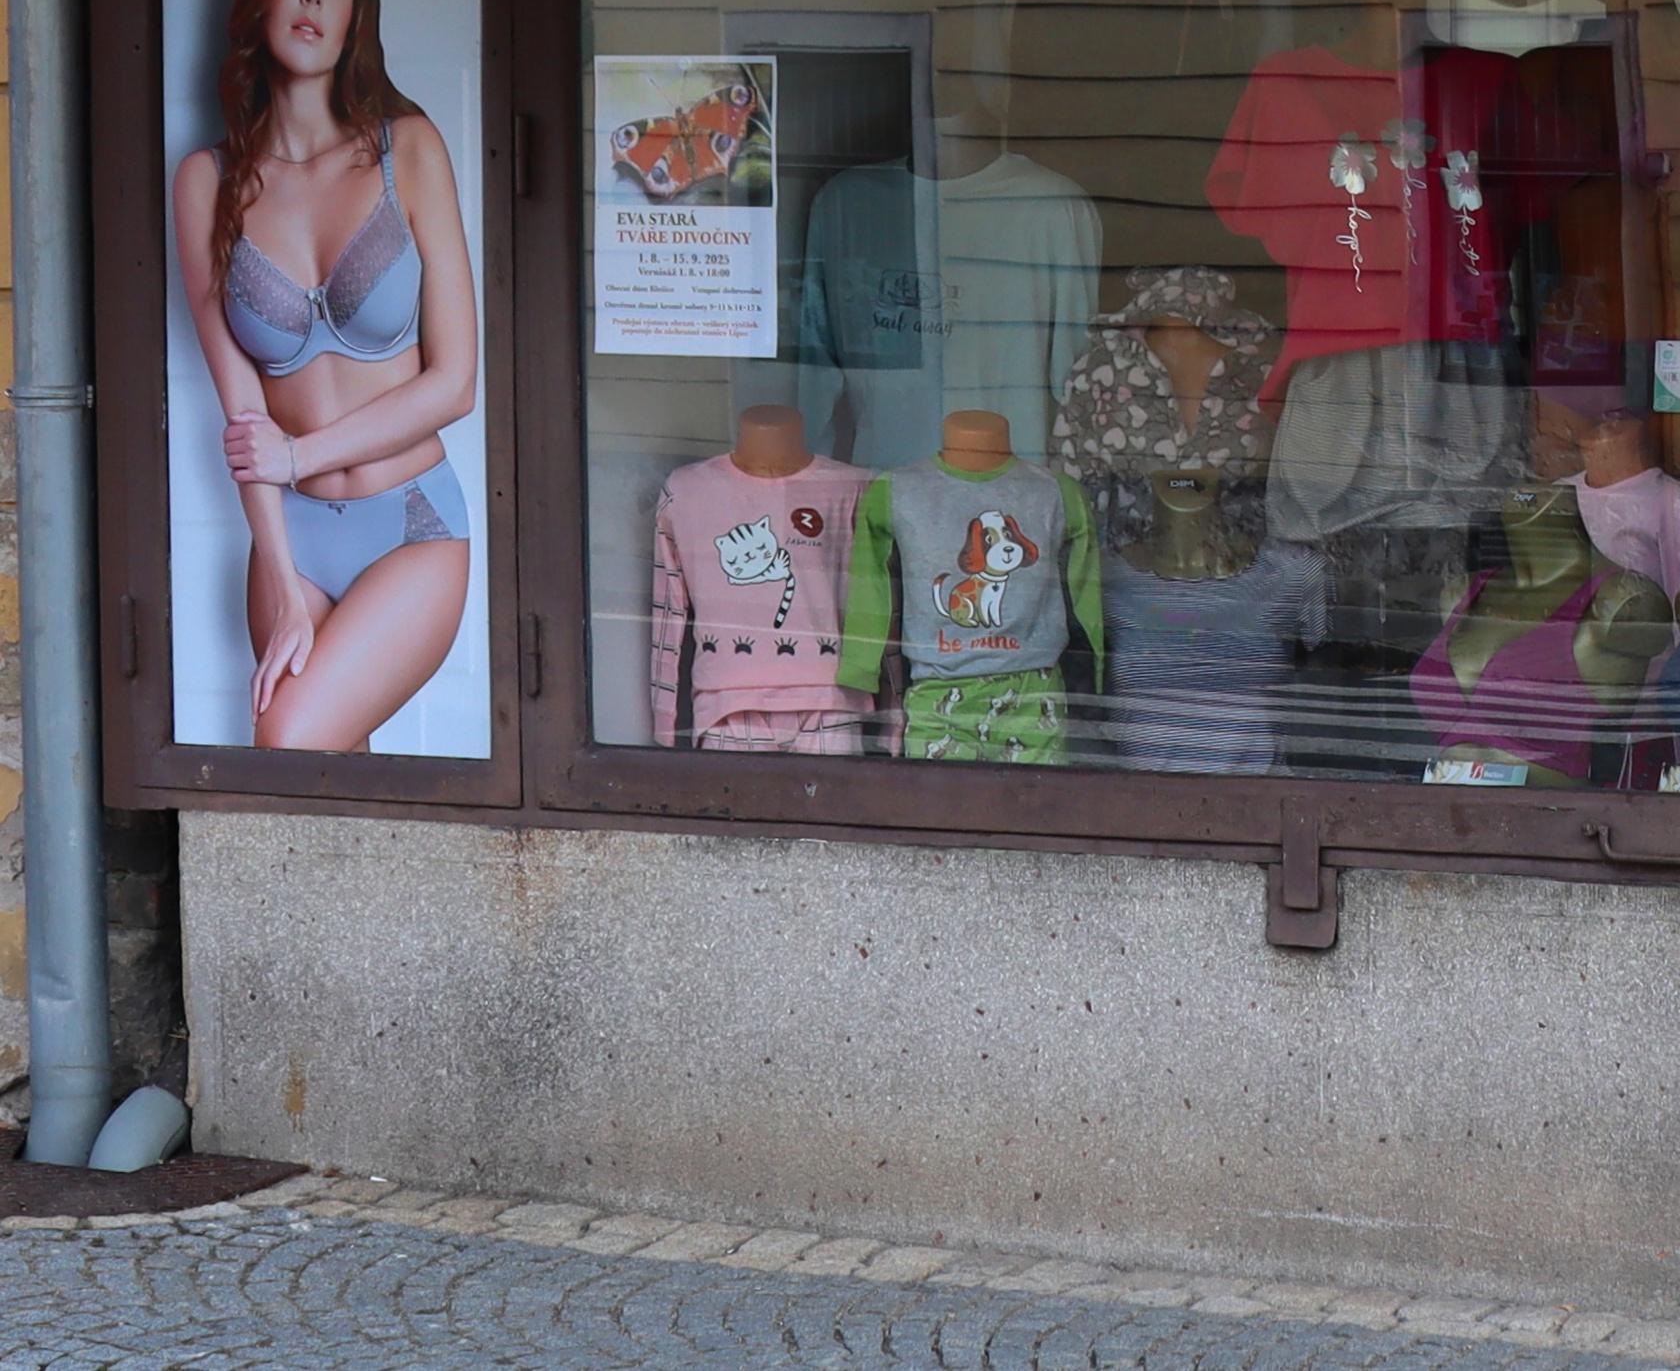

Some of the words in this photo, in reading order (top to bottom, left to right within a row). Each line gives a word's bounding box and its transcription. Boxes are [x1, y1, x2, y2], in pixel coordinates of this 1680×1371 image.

[616, 212, 645, 226] EVA
[649, 210, 697, 226] STARÁ
[616, 227, 668, 244] TVÁŘE
[672, 227, 752, 245] DIVOČINY
[639, 253, 648, 264] 1.
[650, 253, 660, 264] 8.
[673, 253, 688, 264] 15.
[691, 254, 701, 265] 9.
[705, 254, 730, 265] 2025
[938, 629, 962, 653] be
[970, 631, 1021, 650] mine
